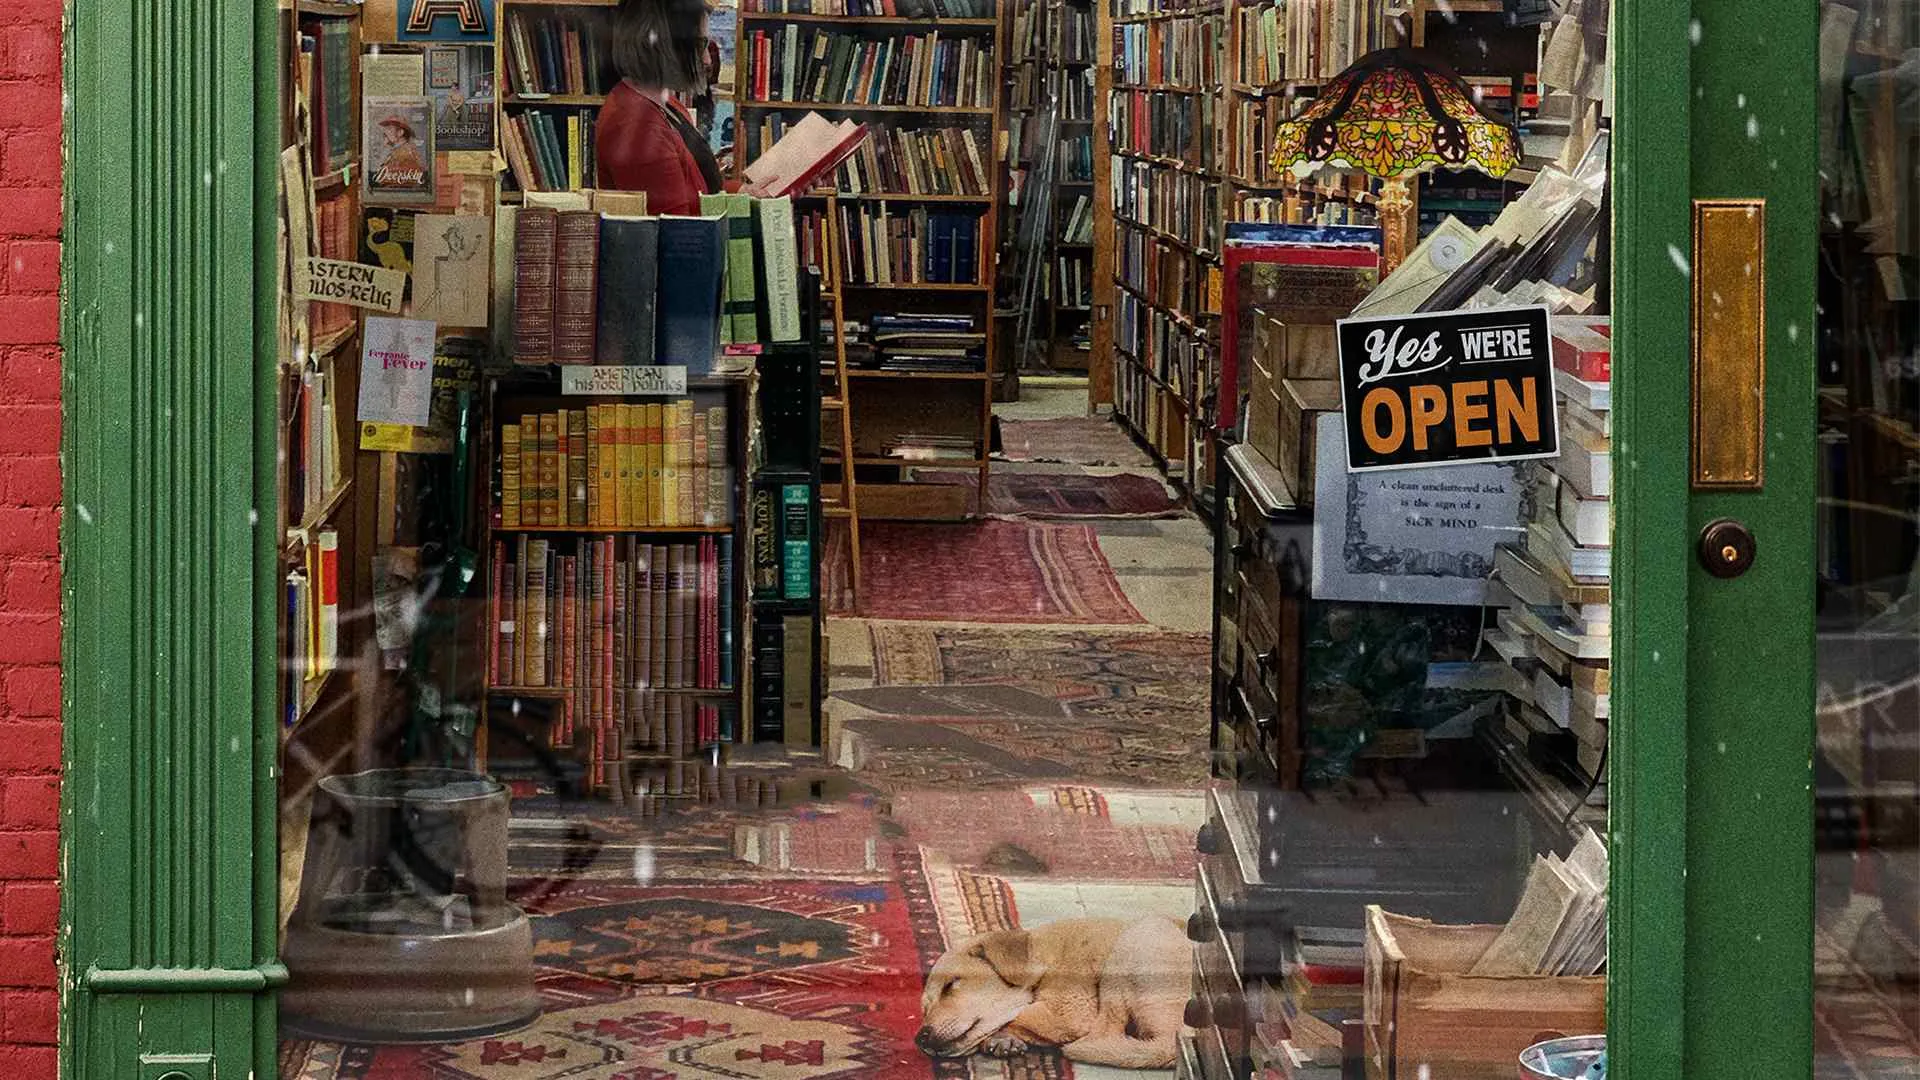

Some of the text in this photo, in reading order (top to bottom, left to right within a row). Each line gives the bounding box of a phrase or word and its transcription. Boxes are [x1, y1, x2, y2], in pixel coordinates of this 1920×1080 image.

[308, 260, 376, 284] ASTERN
[368, 349, 411, 360] Ferrante
[1358, 326, 1532, 389] Yes WE'RE
[382, 357, 428, 371] Fever
[593, 367, 663, 380] AMERICAN
[1361, 376, 1540, 454] OPEN
[1379, 480, 1505, 494] A clean uncluttered desk
[1414, 498, 1429, 508] the
[1435, 500, 1456, 511] sign
[1461, 500, 1471, 509] of
[1405, 516, 1478, 529] SICK MIND
